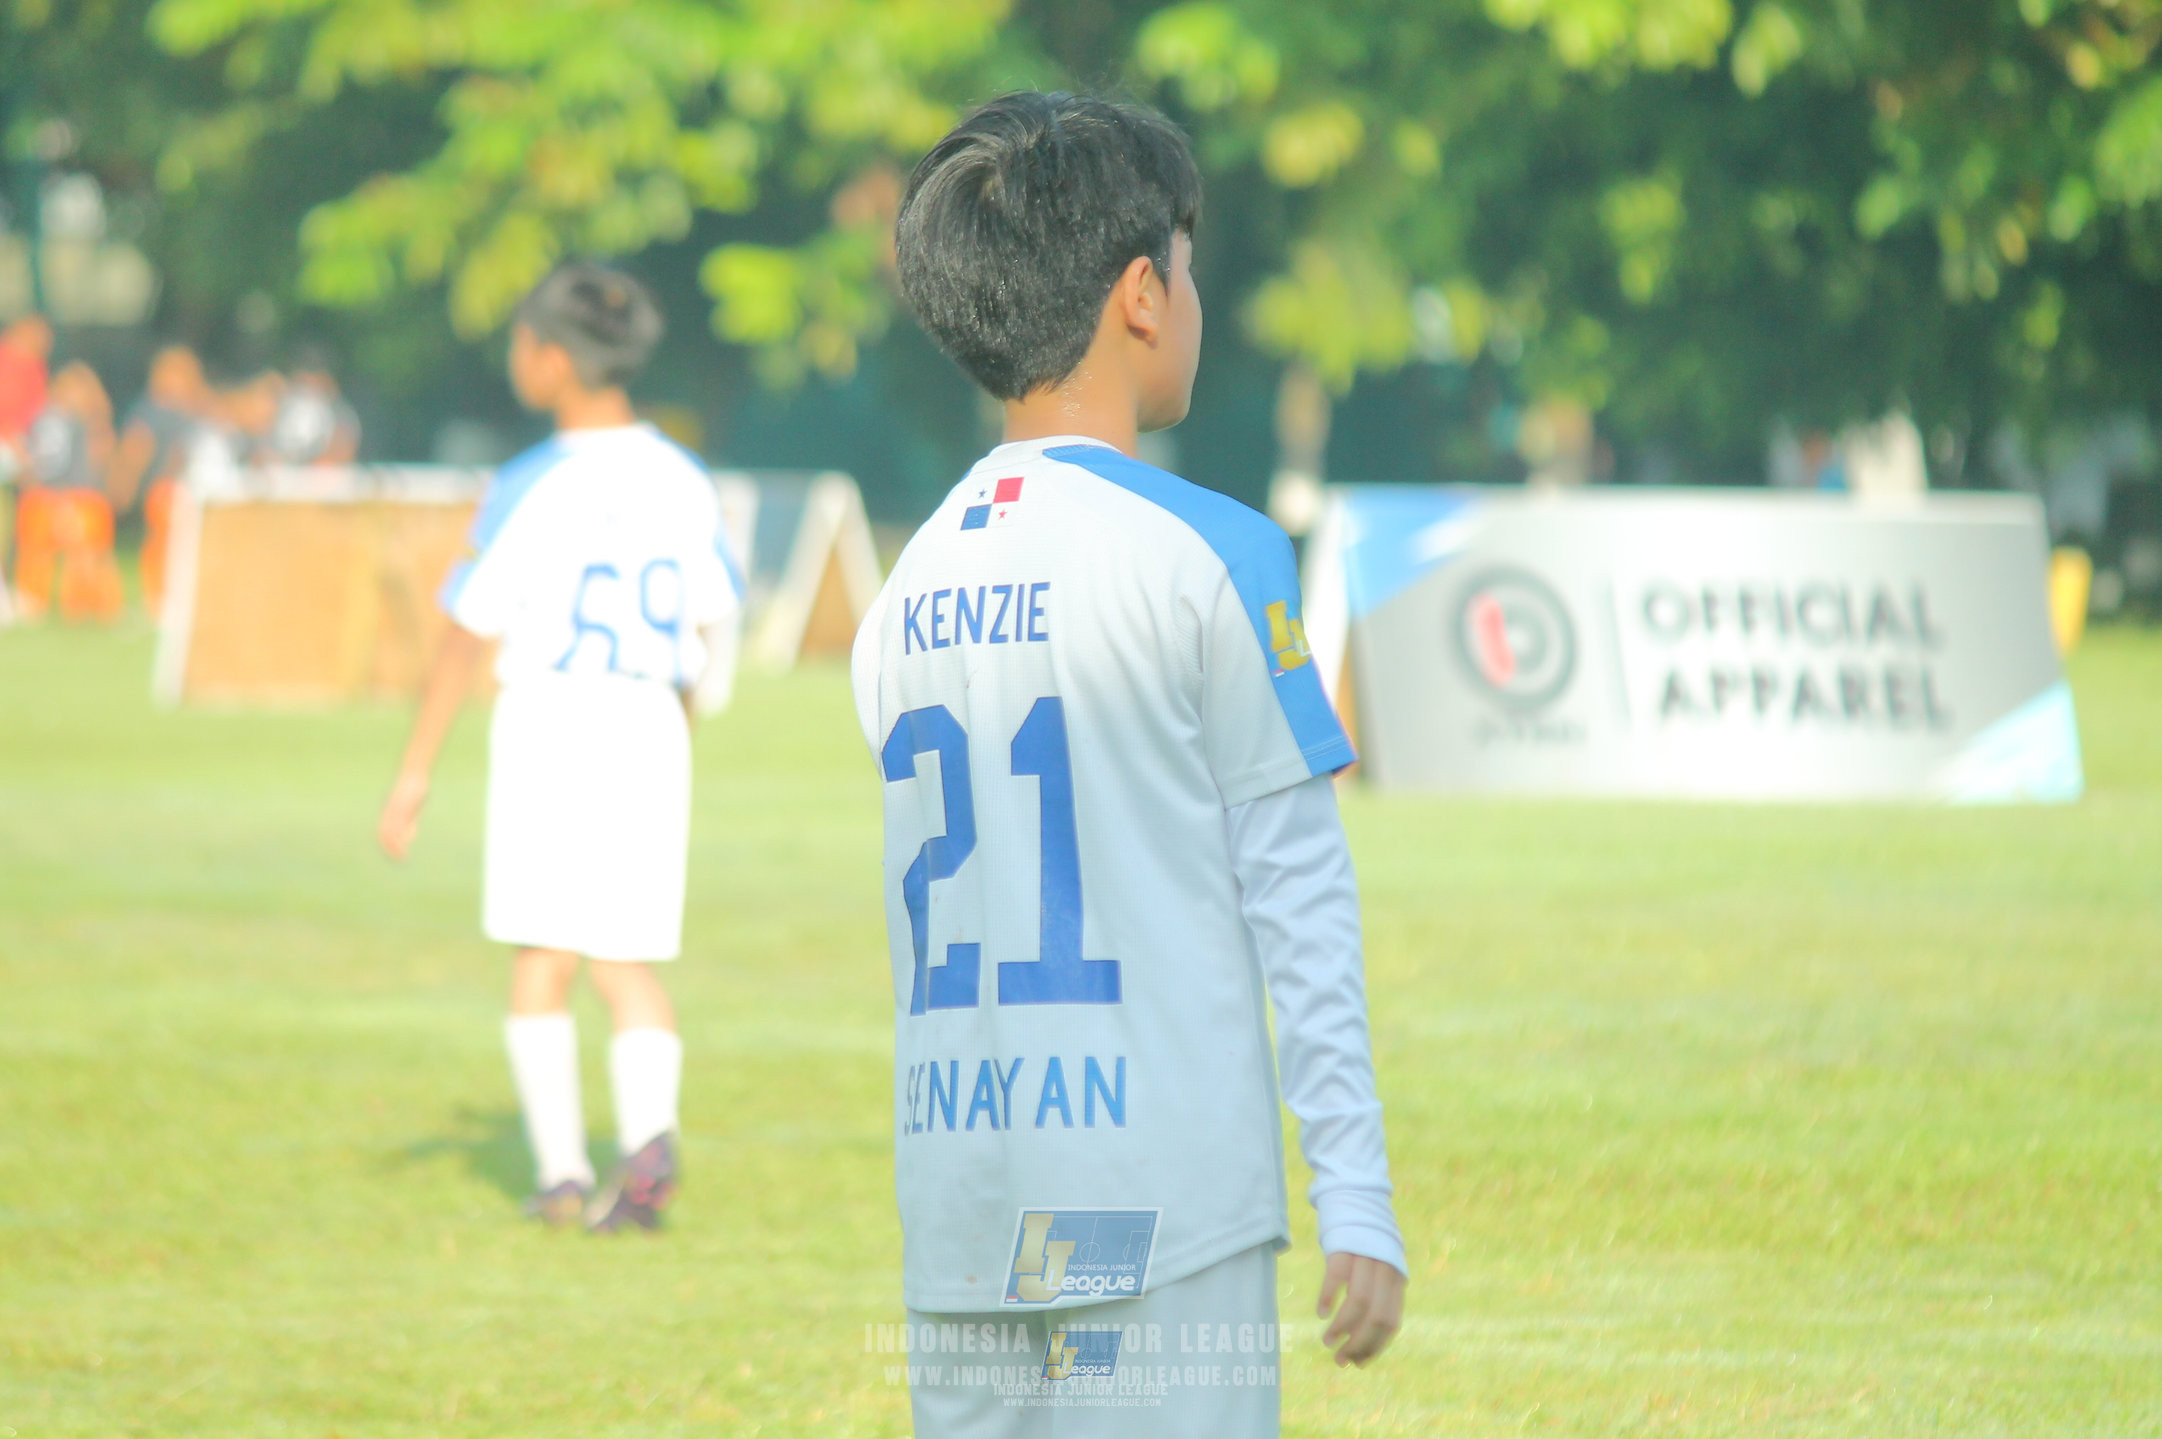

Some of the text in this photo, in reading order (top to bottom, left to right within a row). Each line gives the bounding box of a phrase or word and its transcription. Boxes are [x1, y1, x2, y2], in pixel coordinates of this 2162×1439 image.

[904, 581, 1051, 655] KENZIE
[1641, 580, 1945, 648] OFFICIAL
[1659, 664, 1951, 729] APPAREL
[881, 696, 1123, 1016] 21
